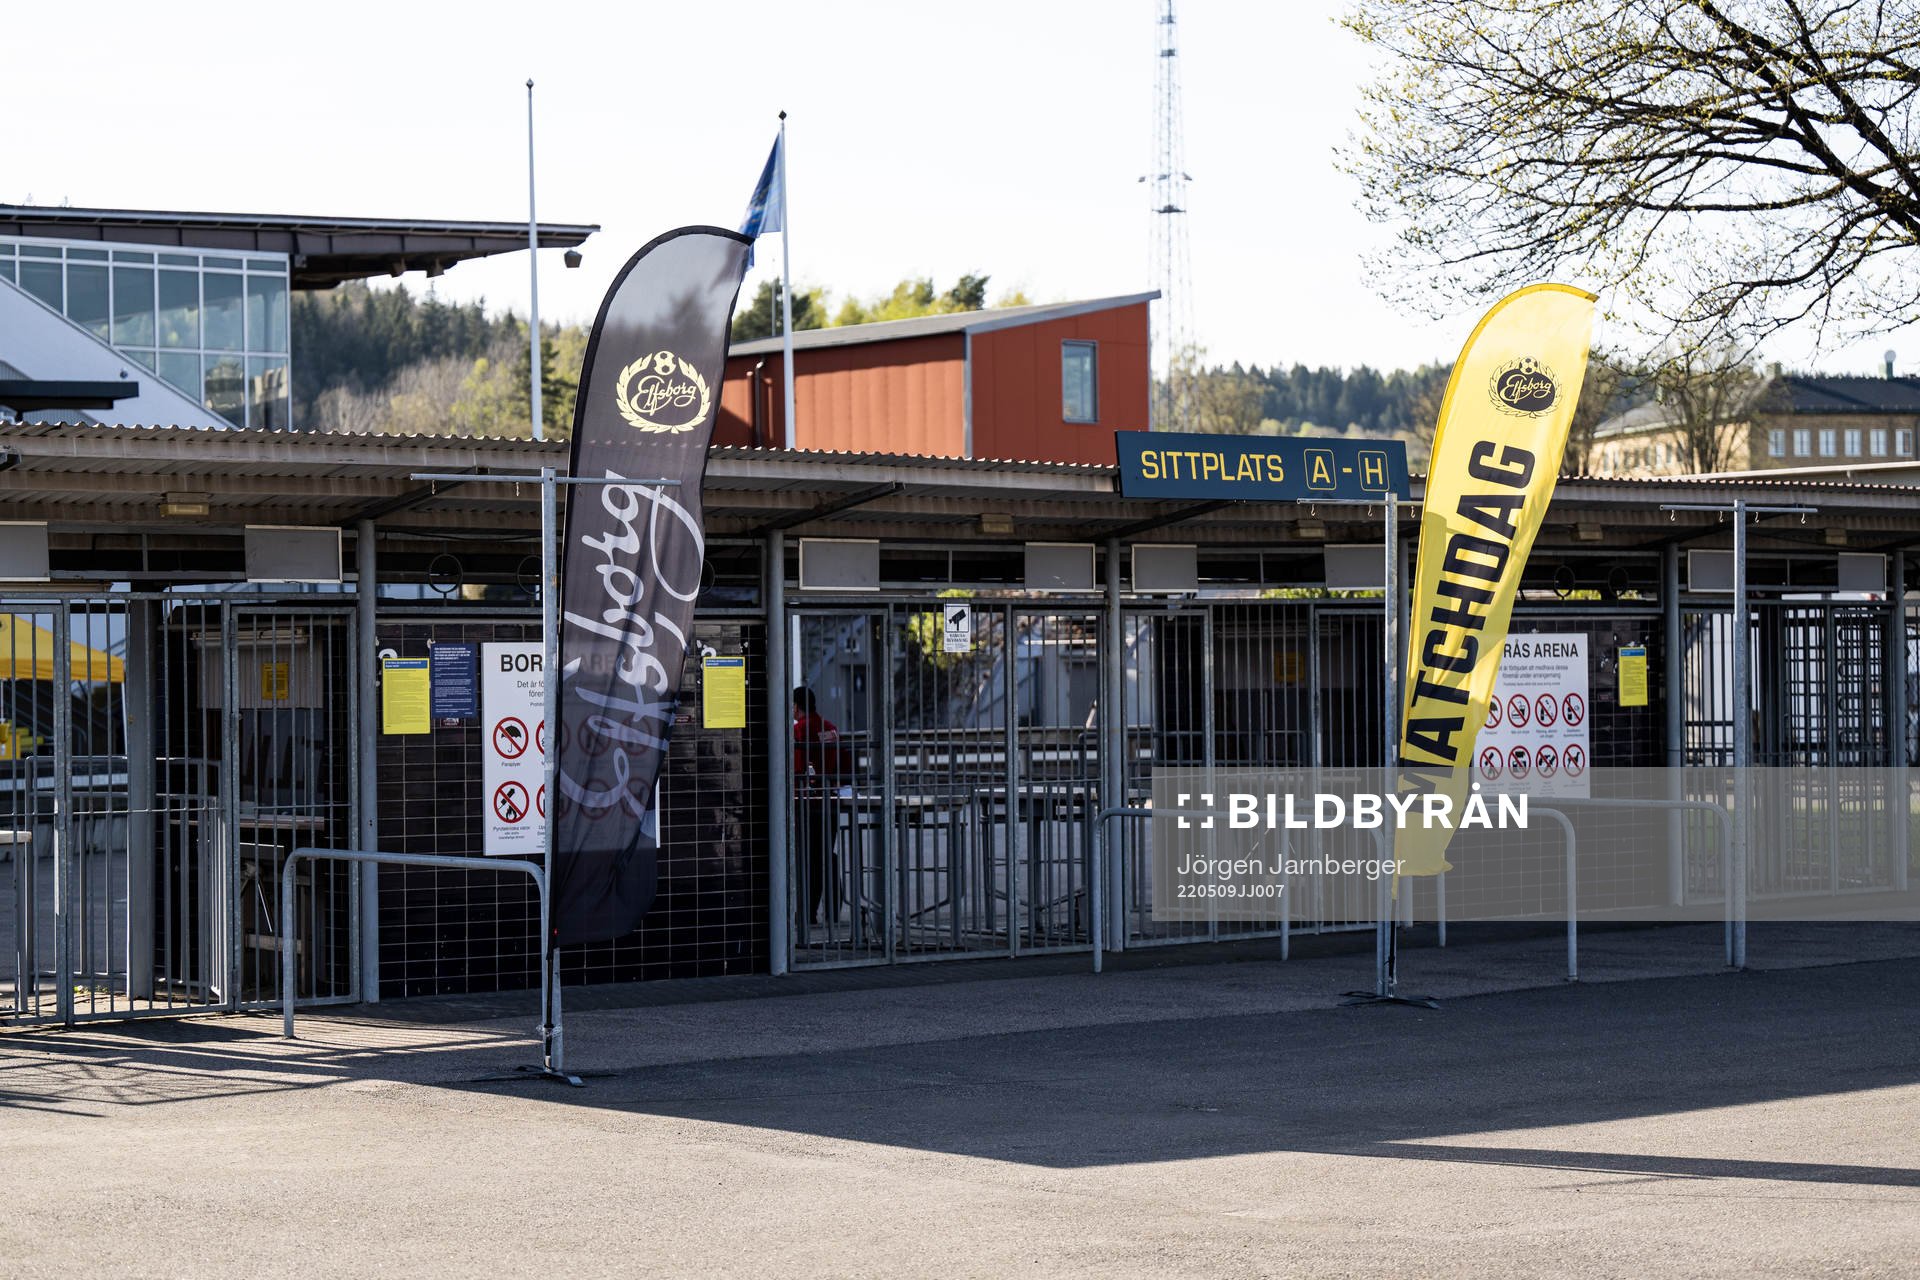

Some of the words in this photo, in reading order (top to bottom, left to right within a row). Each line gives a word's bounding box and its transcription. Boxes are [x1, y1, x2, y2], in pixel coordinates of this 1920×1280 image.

[630, 375, 697, 416] Elfsborg
[1499, 374, 1551, 404] Elfsborg
[1140, 450, 1285, 482] SITTPLATS
[1312, 455, 1331, 484] A
[1364, 457, 1384, 485] H
[500, 653, 544, 673] BOR
[1503, 638, 1531, 659] RÅS
[1533, 642, 1579, 659] ARENA
